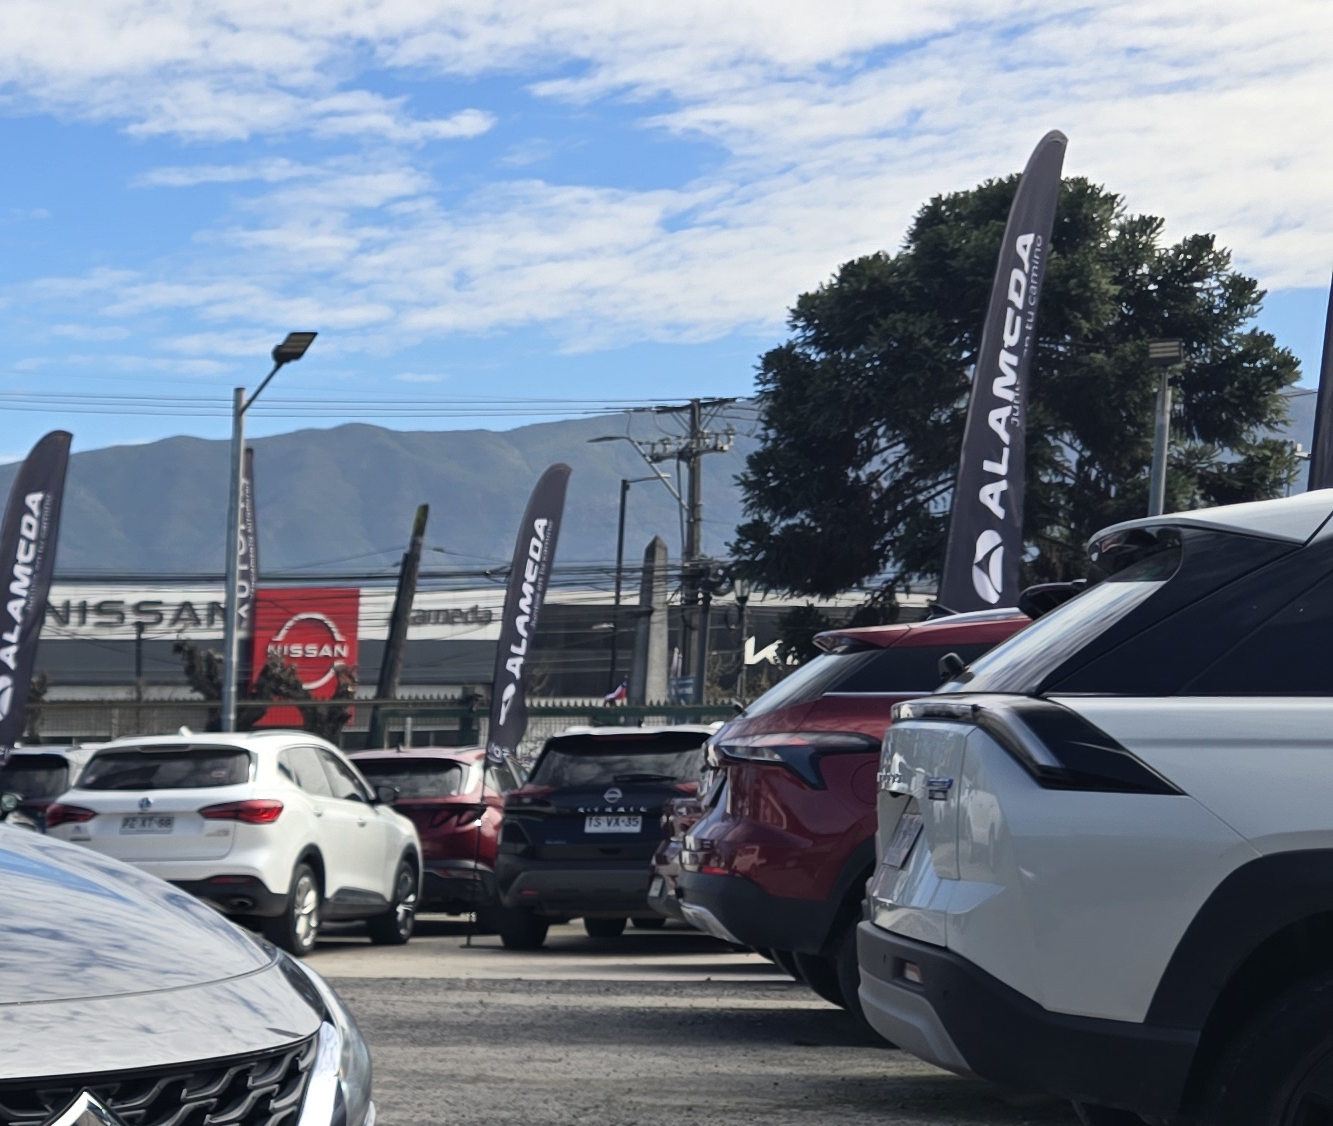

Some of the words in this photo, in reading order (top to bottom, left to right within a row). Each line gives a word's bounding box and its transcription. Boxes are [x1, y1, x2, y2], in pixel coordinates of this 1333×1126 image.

[1028, 235, 1042, 306] camino
[979, 233, 1034, 519] ALAMEDA
[0, 491, 44, 670] ALAMEDA
[46, 600, 226, 628] NISSAN
[506, 518, 548, 680] ALAMEDA
[267, 643, 349, 658] NISSAN
